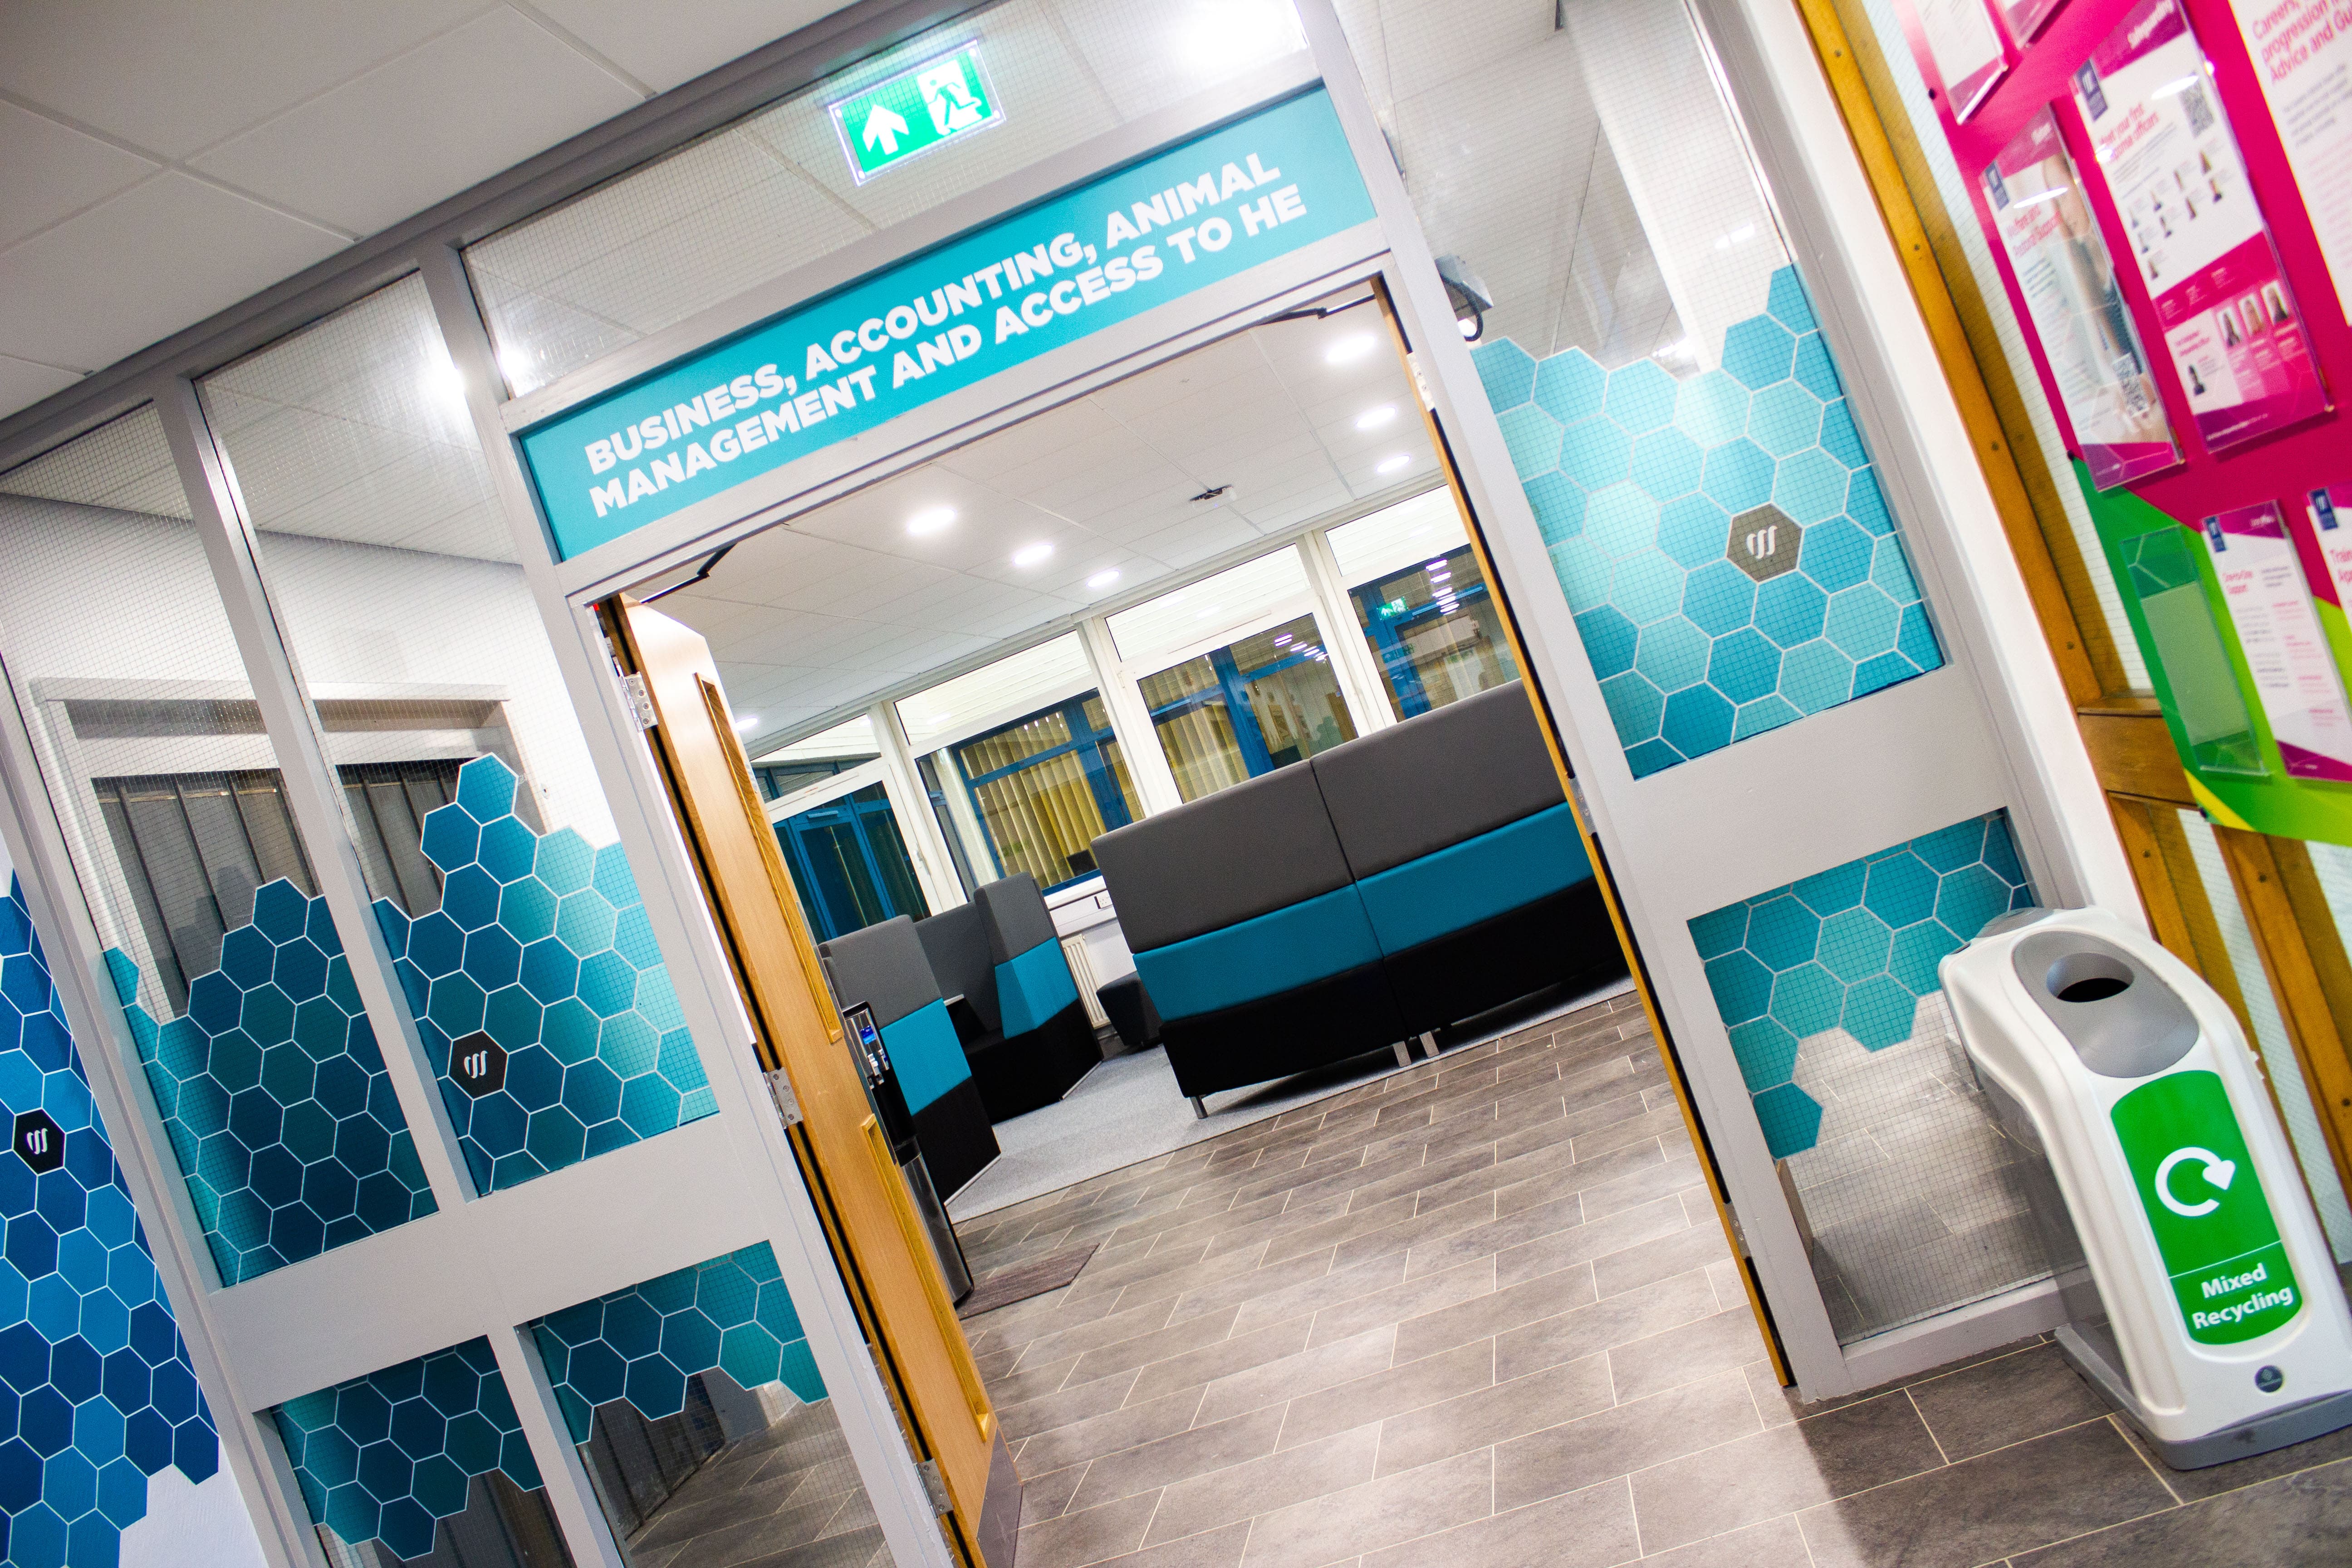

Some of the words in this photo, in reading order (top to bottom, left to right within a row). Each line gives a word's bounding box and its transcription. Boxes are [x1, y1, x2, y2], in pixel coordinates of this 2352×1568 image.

[2270, 44, 2308, 86] Advice
[2309, 19, 2334, 53] and
[584, 364, 796, 475] BUSINESS,
[806, 232, 1096, 380] ACCOUNTING,
[1106, 152, 1281, 250] ANIMAL
[589, 365, 877, 518] MANAGEMENT
[892, 324, 981, 389] AND
[995, 245, 1163, 344] ACCESS
[1166, 217, 1232, 264] TO
[1239, 184, 1307, 236] HE
[2192, 1287, 2293, 1329] Recycling
[2201, 1263, 2268, 1299] Mixed
